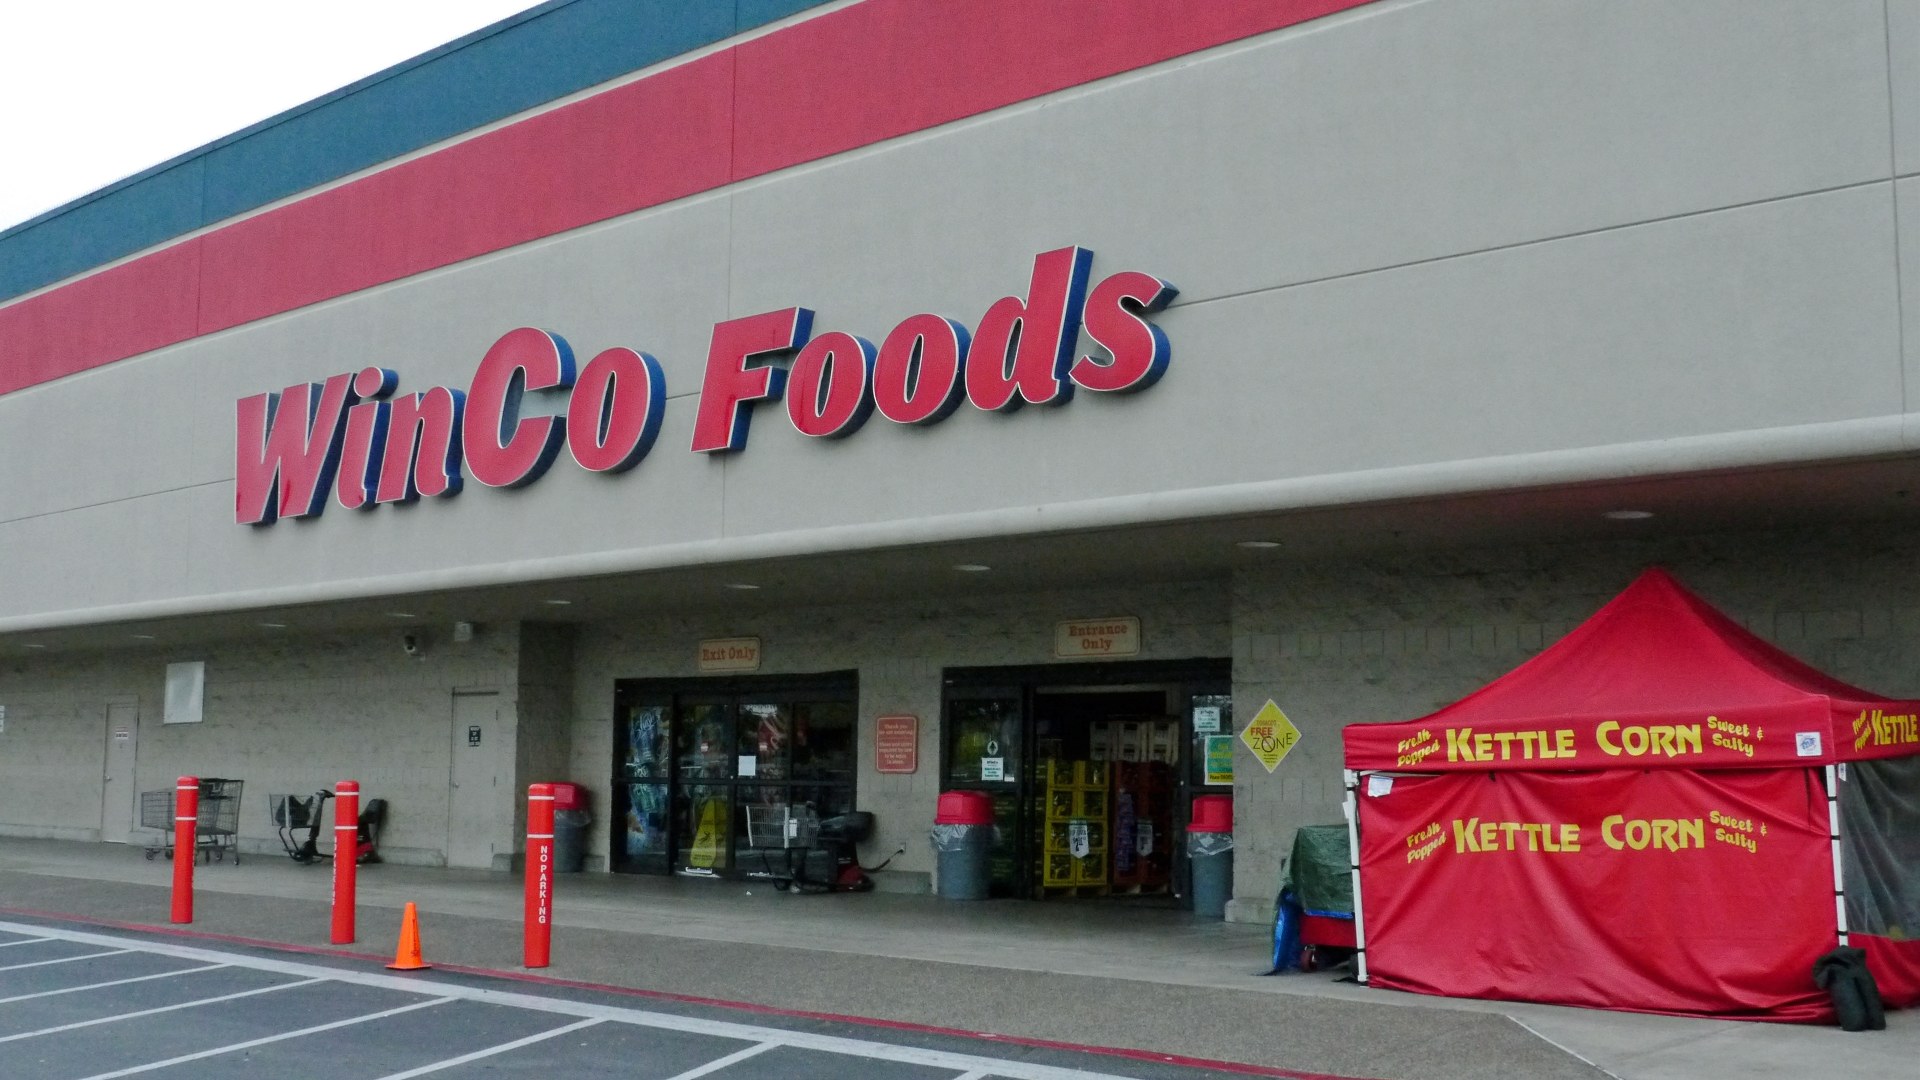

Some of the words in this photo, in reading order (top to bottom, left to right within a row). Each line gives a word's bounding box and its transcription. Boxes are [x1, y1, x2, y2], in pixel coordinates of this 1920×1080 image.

[235, 326, 667, 527] WinCo
[690, 245, 1180, 454] Foods
[1069, 624, 1128, 637] Entrance
[703, 648, 725, 661] Exit
[729, 646, 756, 661] Only
[1082, 638, 1112, 651] Only
[1250, 727, 1273, 737] FREE
[1706, 715, 1750, 737] Sweet
[1756, 726, 1764, 741] &
[1871, 709, 1919, 746] KETTLE
[1253, 732, 1292, 753] ZONE
[1397, 728, 1432, 753] Fresh
[1445, 728, 1577, 762] KETTLE
[1595, 720, 1703, 758] CORN
[1712, 733, 1754, 757] Salty
[1406, 821, 1442, 848] Fresh
[1452, 817, 1581, 853] KETTLE
[1601, 814, 1705, 853] CORN
[1709, 810, 1753, 833] Sweet
[1760, 822, 1767, 836] &
[1715, 828, 1757, 853] Salty
[540, 845, 548, 863] NO
[538, 865, 547, 924] PARKING
